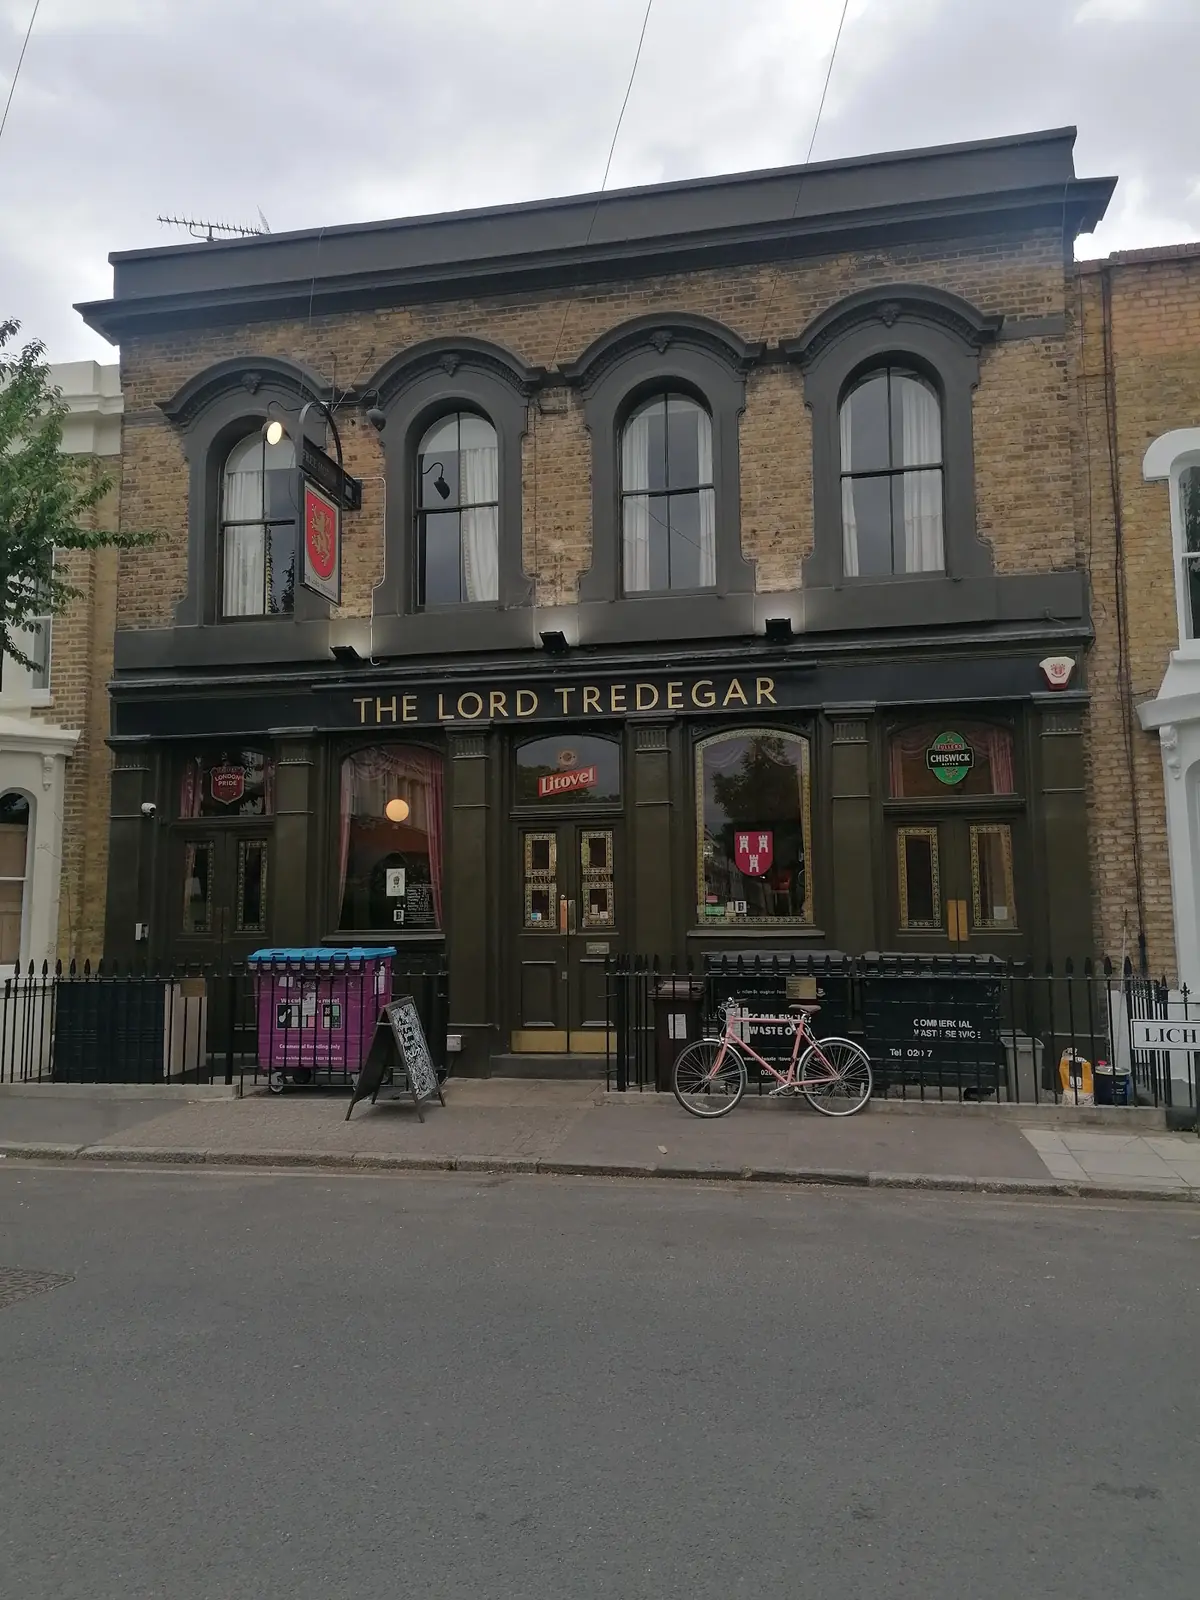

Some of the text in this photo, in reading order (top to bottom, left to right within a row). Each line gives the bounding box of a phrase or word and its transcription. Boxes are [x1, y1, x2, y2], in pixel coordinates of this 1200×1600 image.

[353, 677, 777, 723] THE LORD TREDEGAR
[930, 753, 970, 763] CHISWICK
[214, 773, 241, 782] LONDON
[541, 767, 593, 794] Litovel
[749, 1026, 812, 1037] WASTE OY
[1145, 1028, 1198, 1044] LICH
[307, 1043, 329, 1051] Reccling
[889, 1048, 902, 1056] Tel
[927, 1050, 933, 1058] 7
